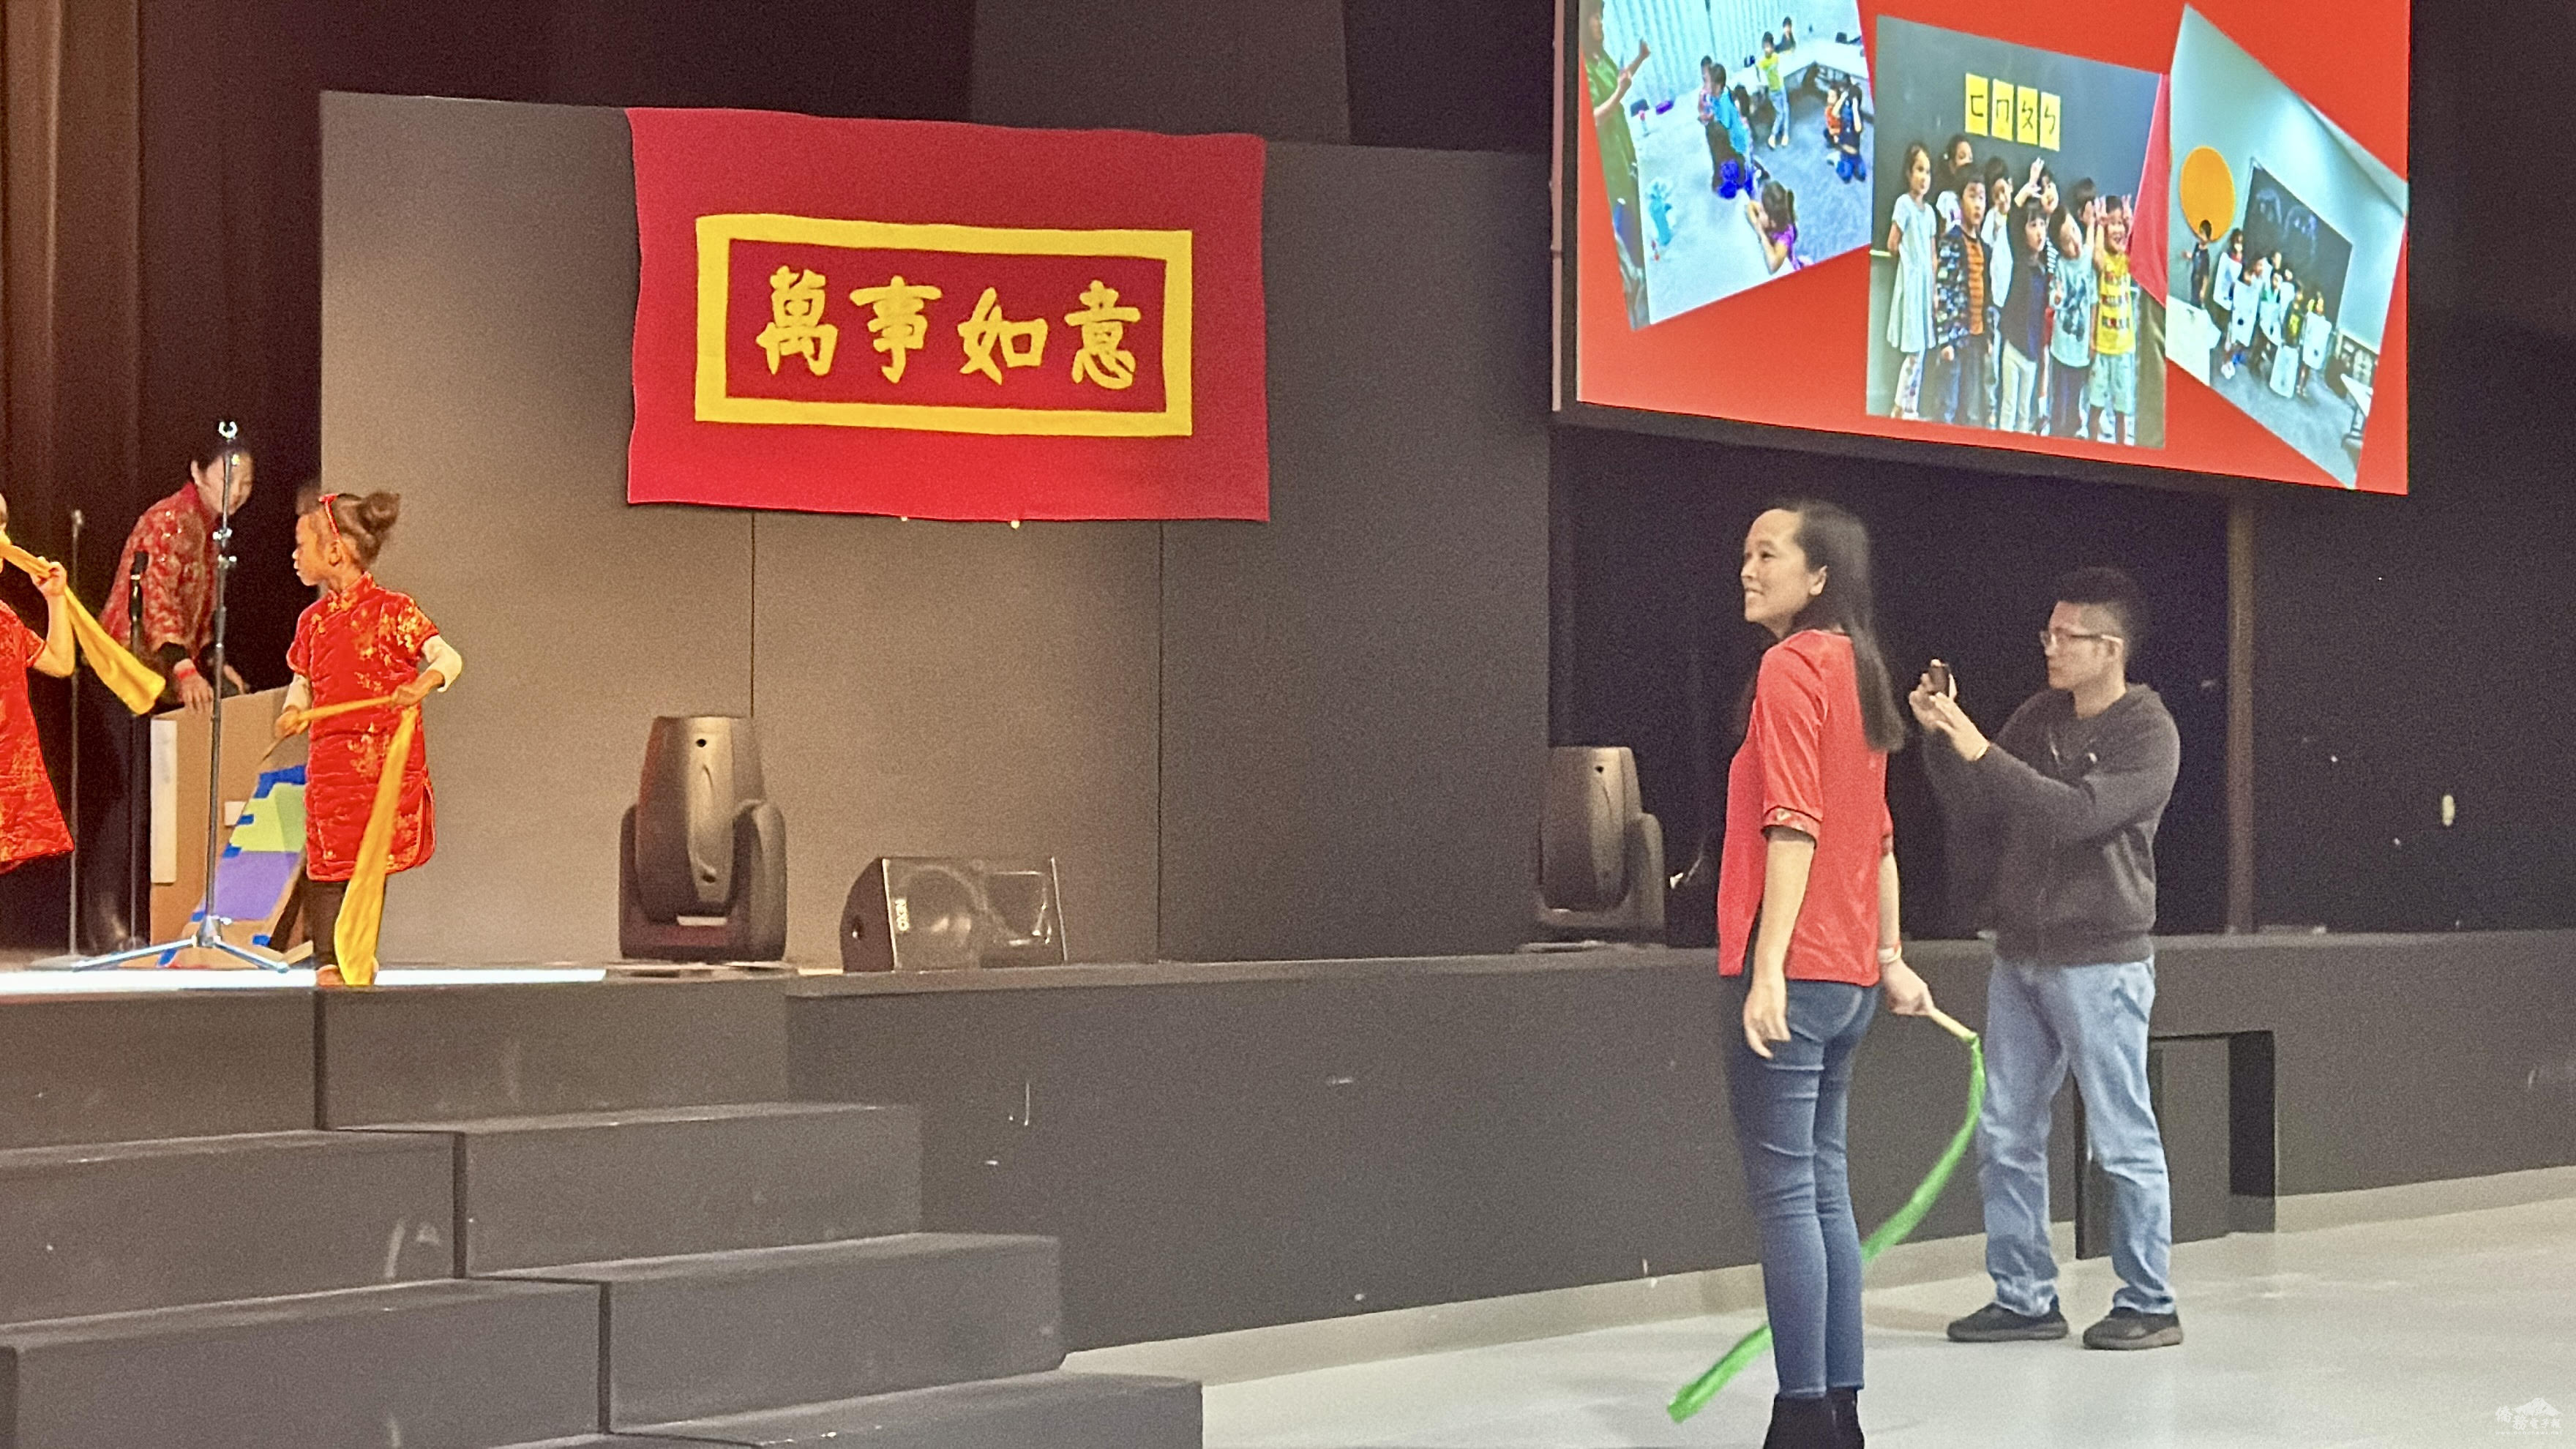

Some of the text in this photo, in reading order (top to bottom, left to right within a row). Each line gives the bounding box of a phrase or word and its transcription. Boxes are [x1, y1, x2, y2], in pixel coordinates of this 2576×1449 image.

[755, 265, 1142, 390] 萬事如意
[894, 898, 910, 932] NEXO
